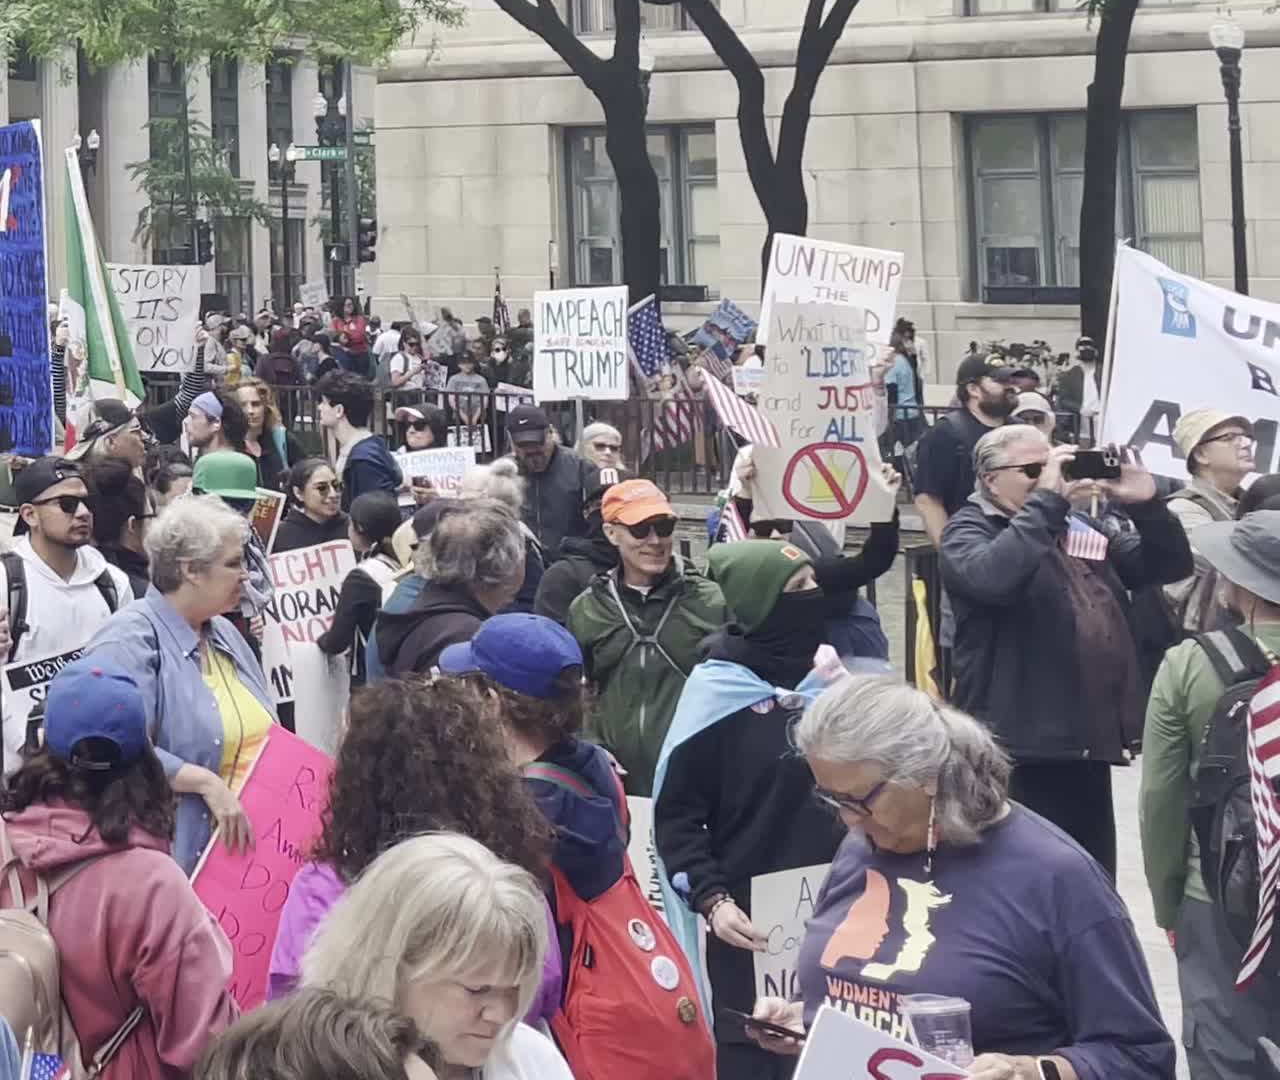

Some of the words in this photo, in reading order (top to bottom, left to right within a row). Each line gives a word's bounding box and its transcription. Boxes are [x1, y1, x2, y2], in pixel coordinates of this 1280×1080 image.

[312, 148, 337, 158] Clark
[814, 286, 848, 302] THE
[131, 297, 183, 322] ITS
[541, 298, 624, 338] IMPEACH
[136, 324, 169, 347] ON
[151, 345, 195, 369] YOU
[540, 349, 625, 389] TRUMP
[764, 392, 802, 412] and
[824, 416, 864, 443] ALL
[825, 976, 907, 1012] WOMEN'S
